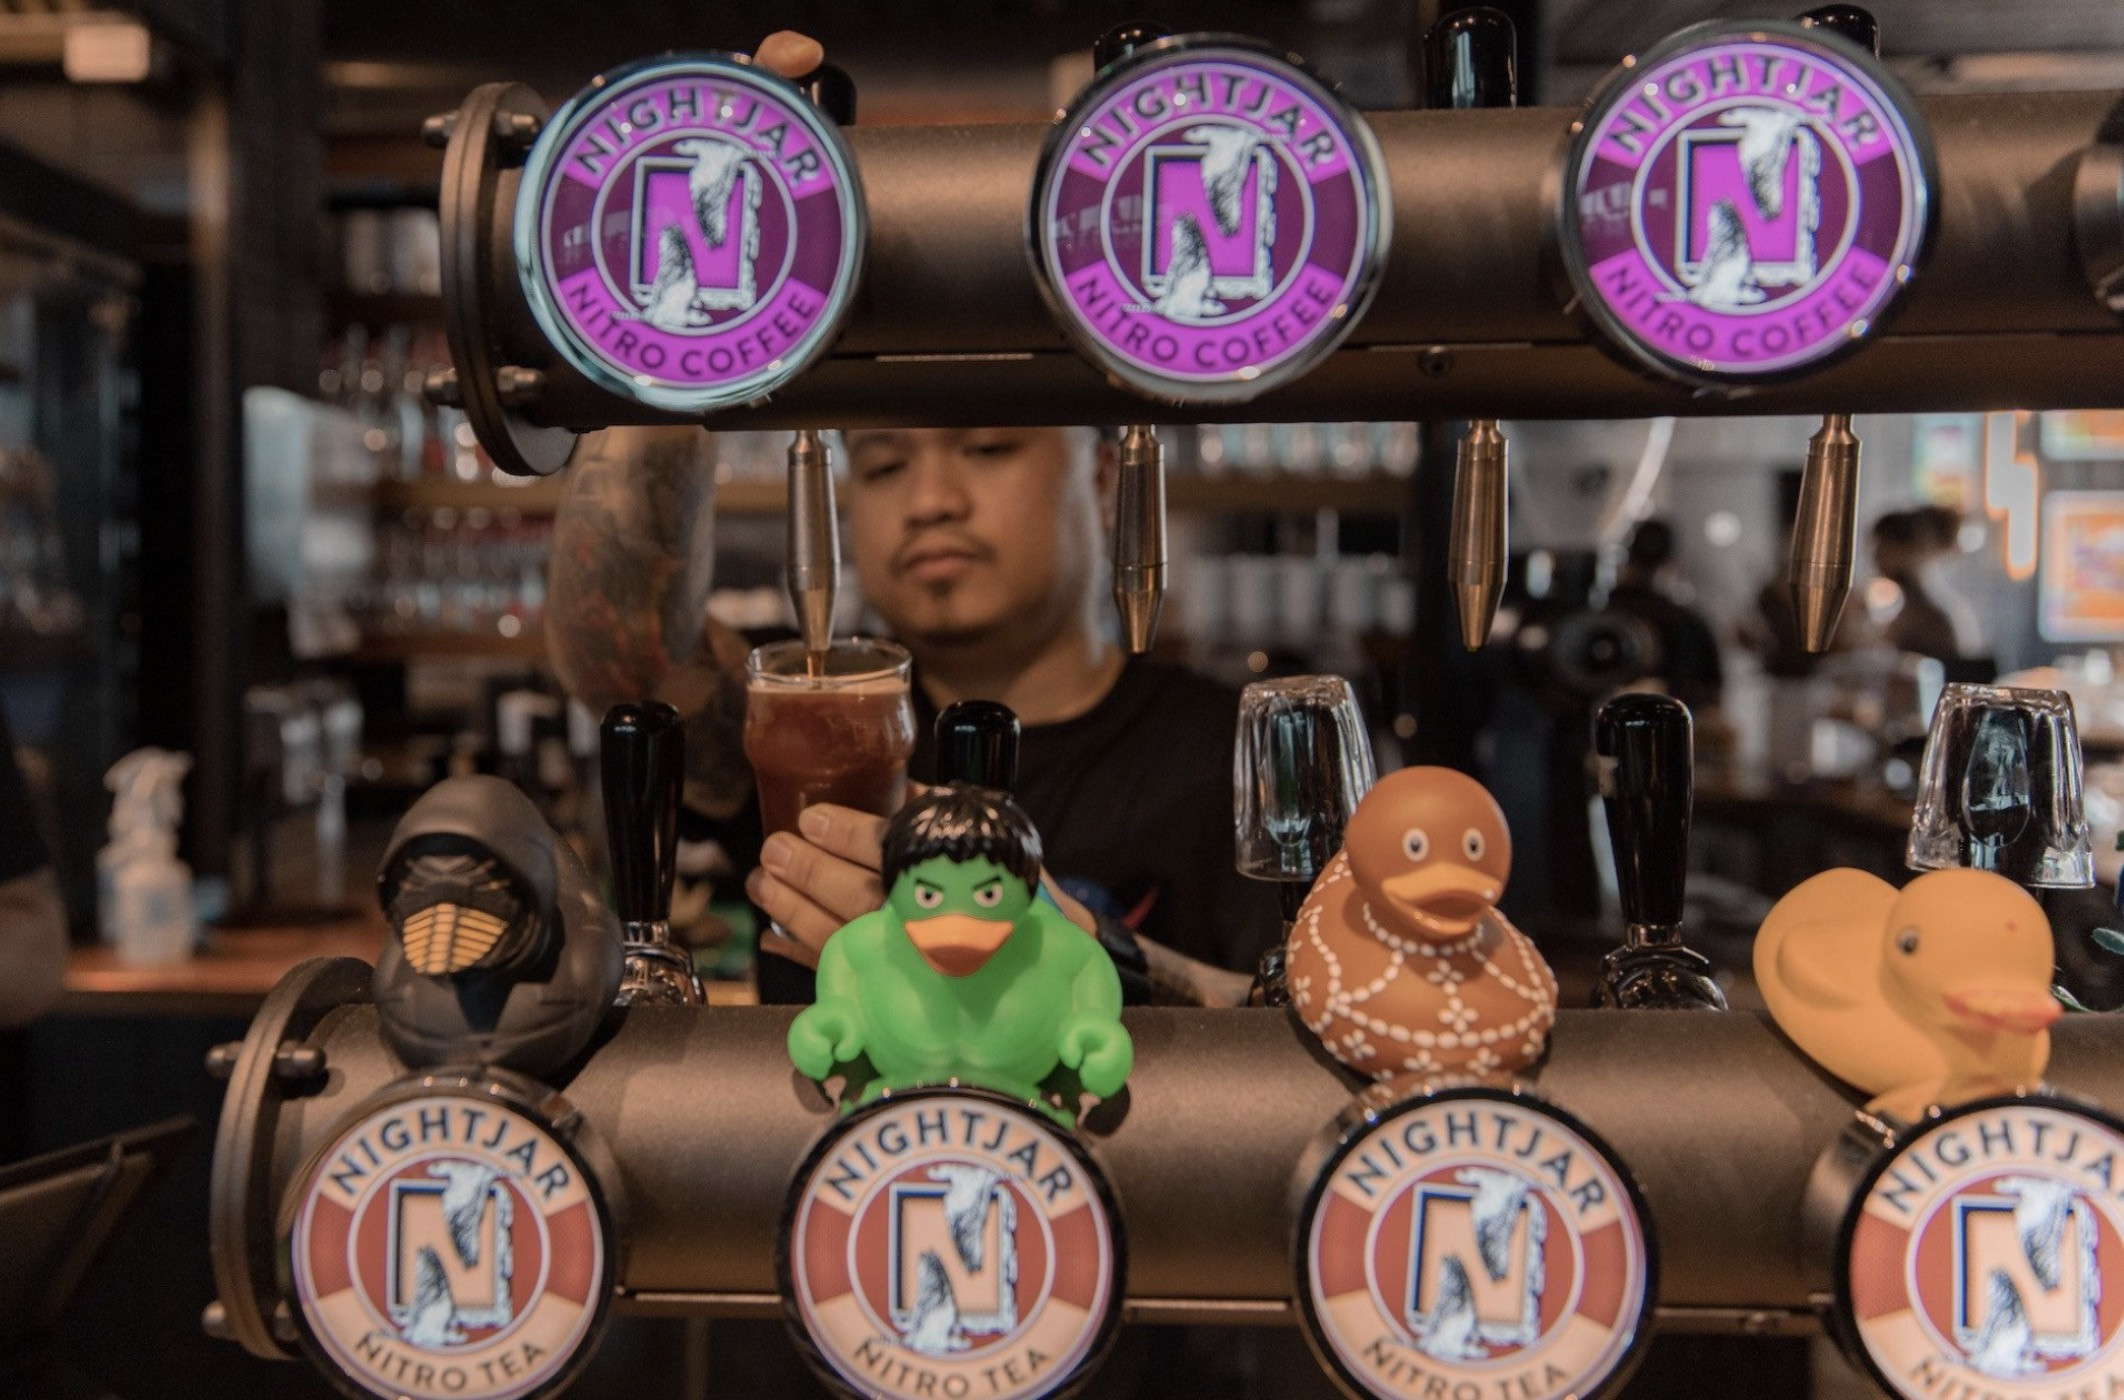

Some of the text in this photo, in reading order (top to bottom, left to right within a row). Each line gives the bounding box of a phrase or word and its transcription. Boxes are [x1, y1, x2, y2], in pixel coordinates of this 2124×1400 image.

[573, 88, 822, 185] NIGHTJAR
[1079, 74, 1337, 169] NIGHTJAR
[1607, 55, 1880, 155] NIGHTJAR
[569, 283, 816, 377] NITRO COFFEE
[1078, 277, 1333, 367] NITRO COFFEE
[1605, 264, 1875, 357] NITRO COFFEE
[330, 1107, 570, 1200] NIGHTJAR
[825, 1109, 1073, 1203] NIGHTJAR
[1346, 1111, 1606, 1216] NIGHTJAR
[1879, 1118, 2124, 1214] NIGHTJA
[355, 1330, 546, 1392] NITRO TEA
[853, 1338, 1048, 1398] NITRO TEA
[1363, 1336, 1570, 1400] NITRO TEA
